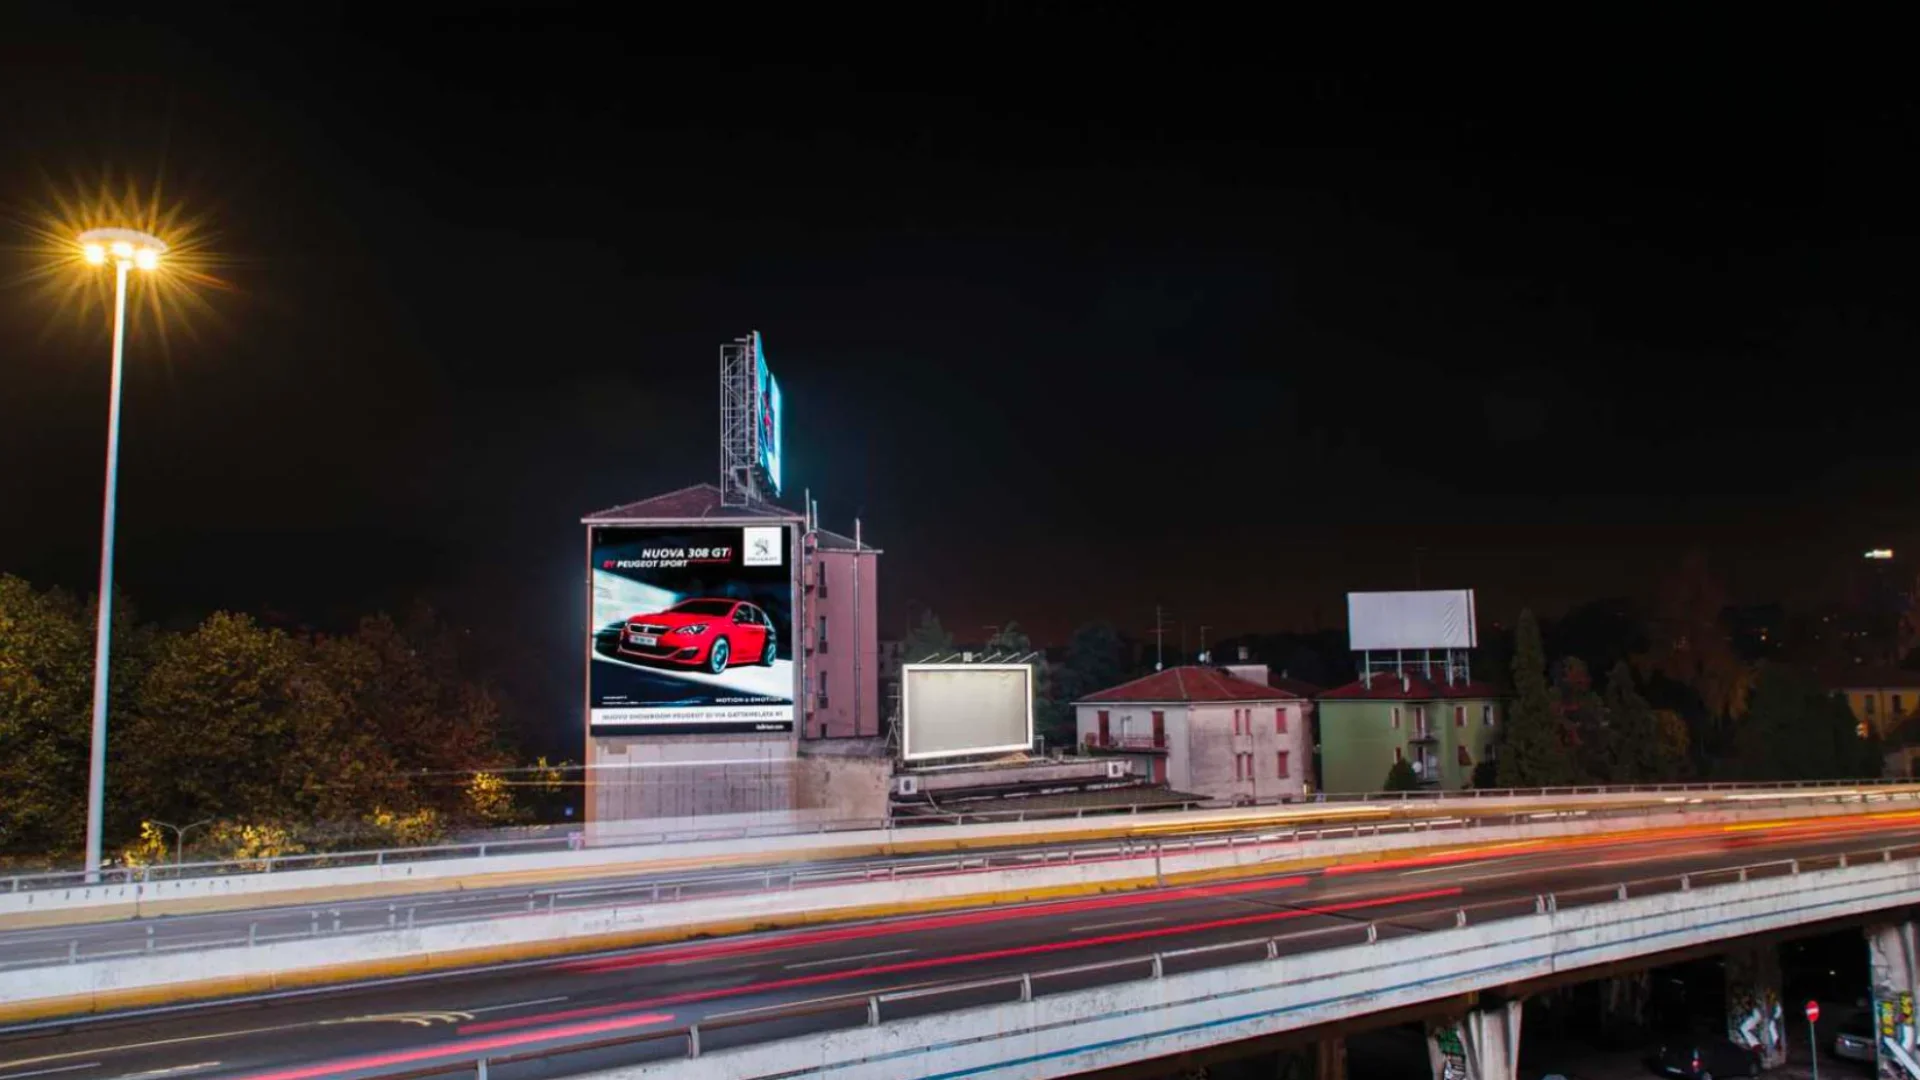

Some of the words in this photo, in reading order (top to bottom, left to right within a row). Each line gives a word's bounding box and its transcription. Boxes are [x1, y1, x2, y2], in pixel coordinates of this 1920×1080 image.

[642, 547, 685, 558] NUOVA
[688, 547, 709, 558] 308
[603, 560, 616, 569] BY
[617, 560, 657, 568] PEUGEOT
[659, 559, 689, 568] SPORT
